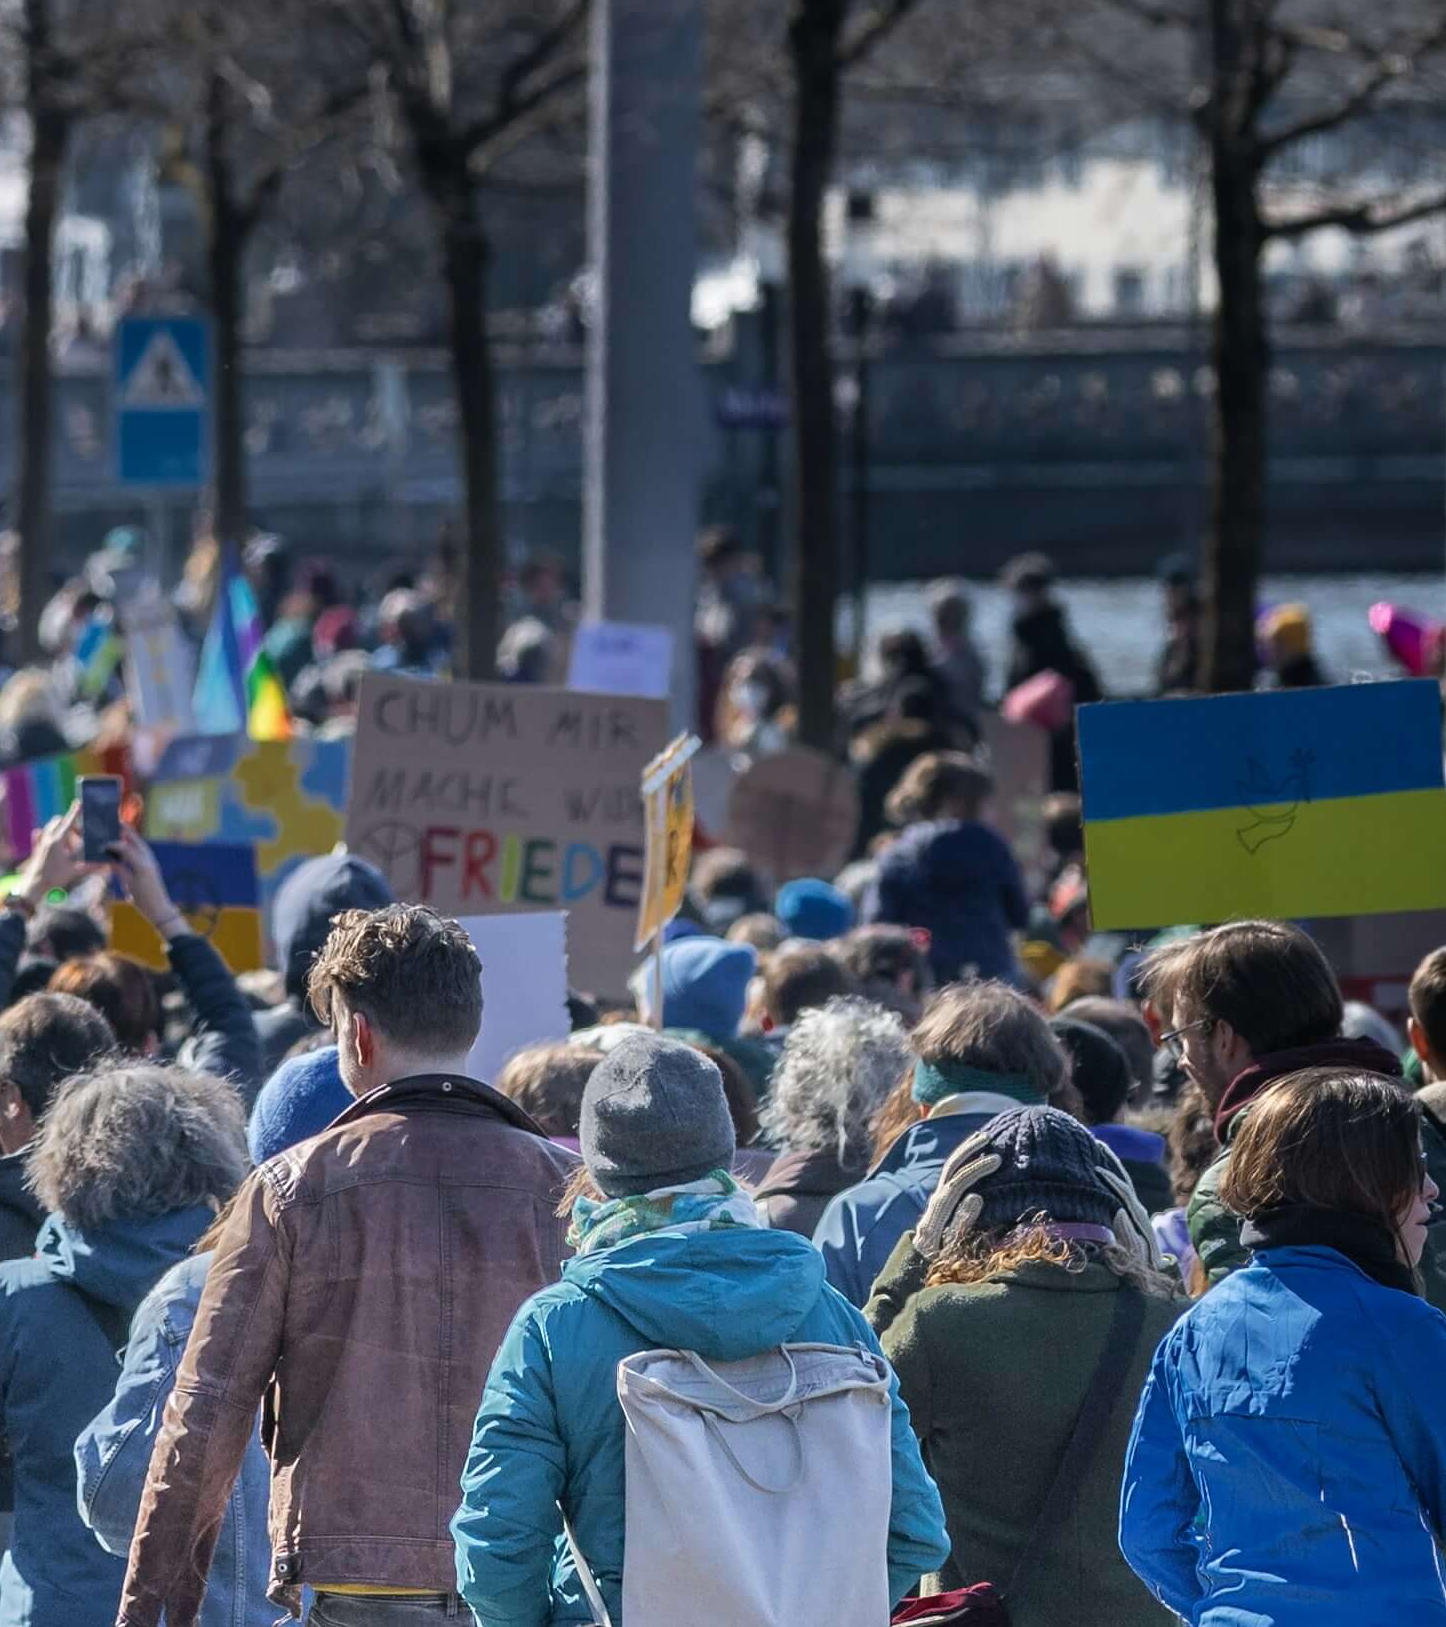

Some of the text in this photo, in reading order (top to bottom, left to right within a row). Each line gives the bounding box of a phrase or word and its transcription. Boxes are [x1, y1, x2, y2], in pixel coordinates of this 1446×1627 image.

[373, 690, 639, 749] CHUM MIR
[365, 768, 529, 820] MACHE
[421, 825, 643, 908] FRIEDE
